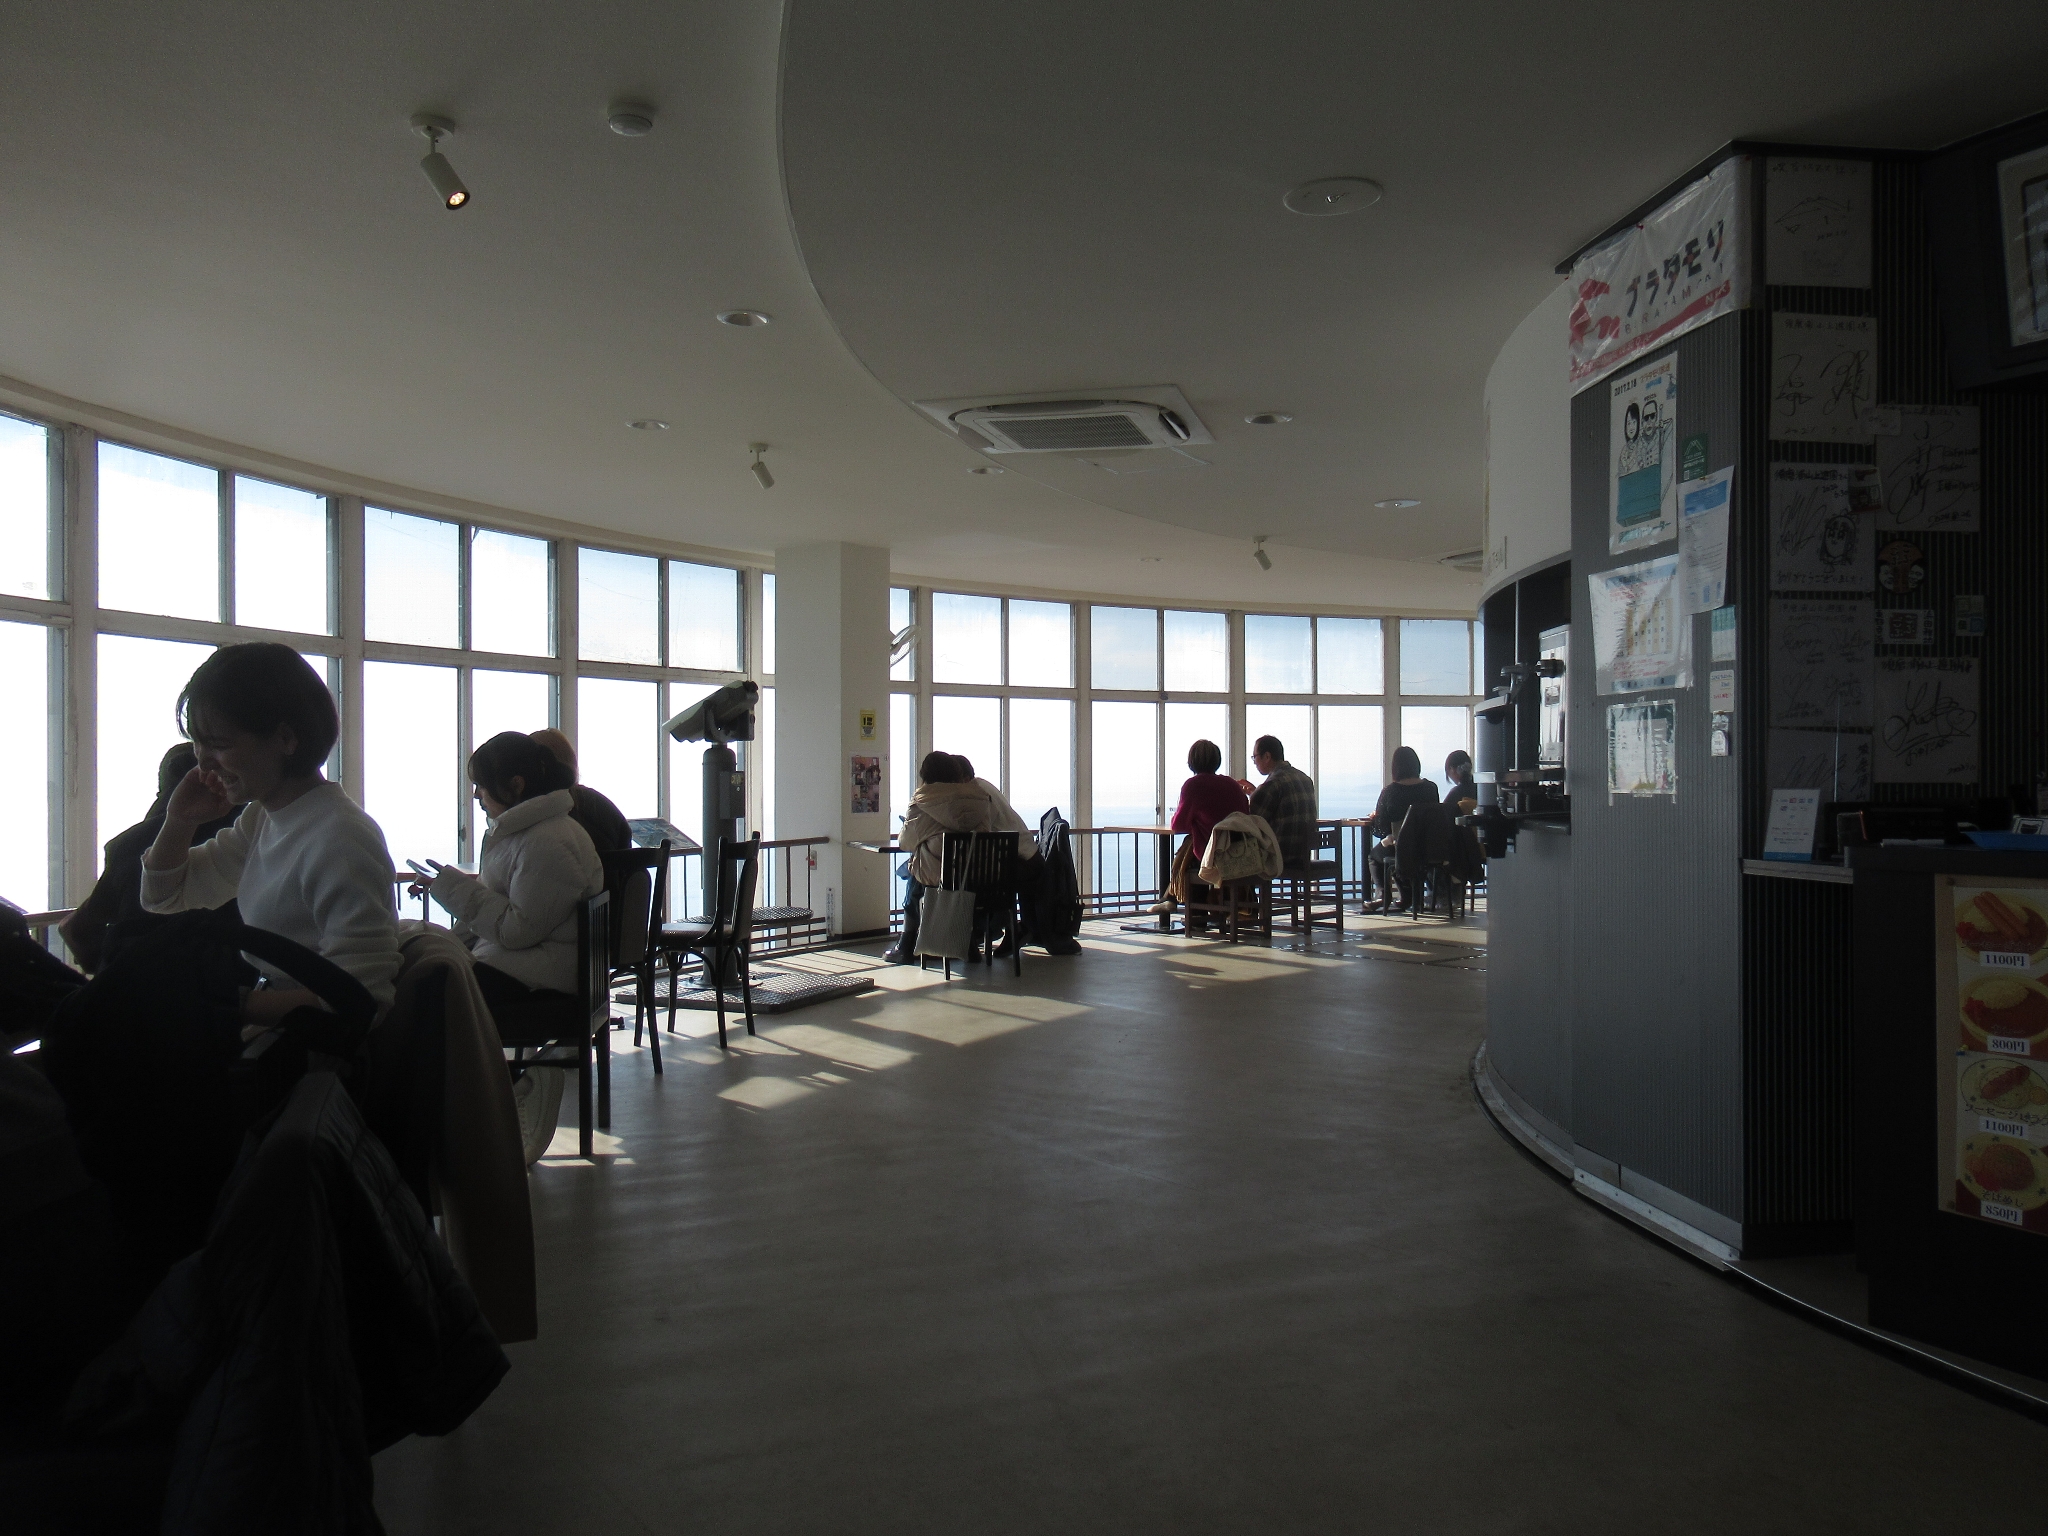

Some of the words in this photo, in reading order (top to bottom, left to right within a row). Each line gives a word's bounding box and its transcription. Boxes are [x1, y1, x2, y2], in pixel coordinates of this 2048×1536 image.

[1625, 219, 1724, 318] ブラタモリ
[1985, 954, 2025, 967] 1100円
[1992, 1039, 2025, 1052] 800円
[1985, 1119, 2024, 1137] 1100円
[1981, 1189, 2024, 1207] そばめし
[1985, 1204, 2018, 1221] 850円
